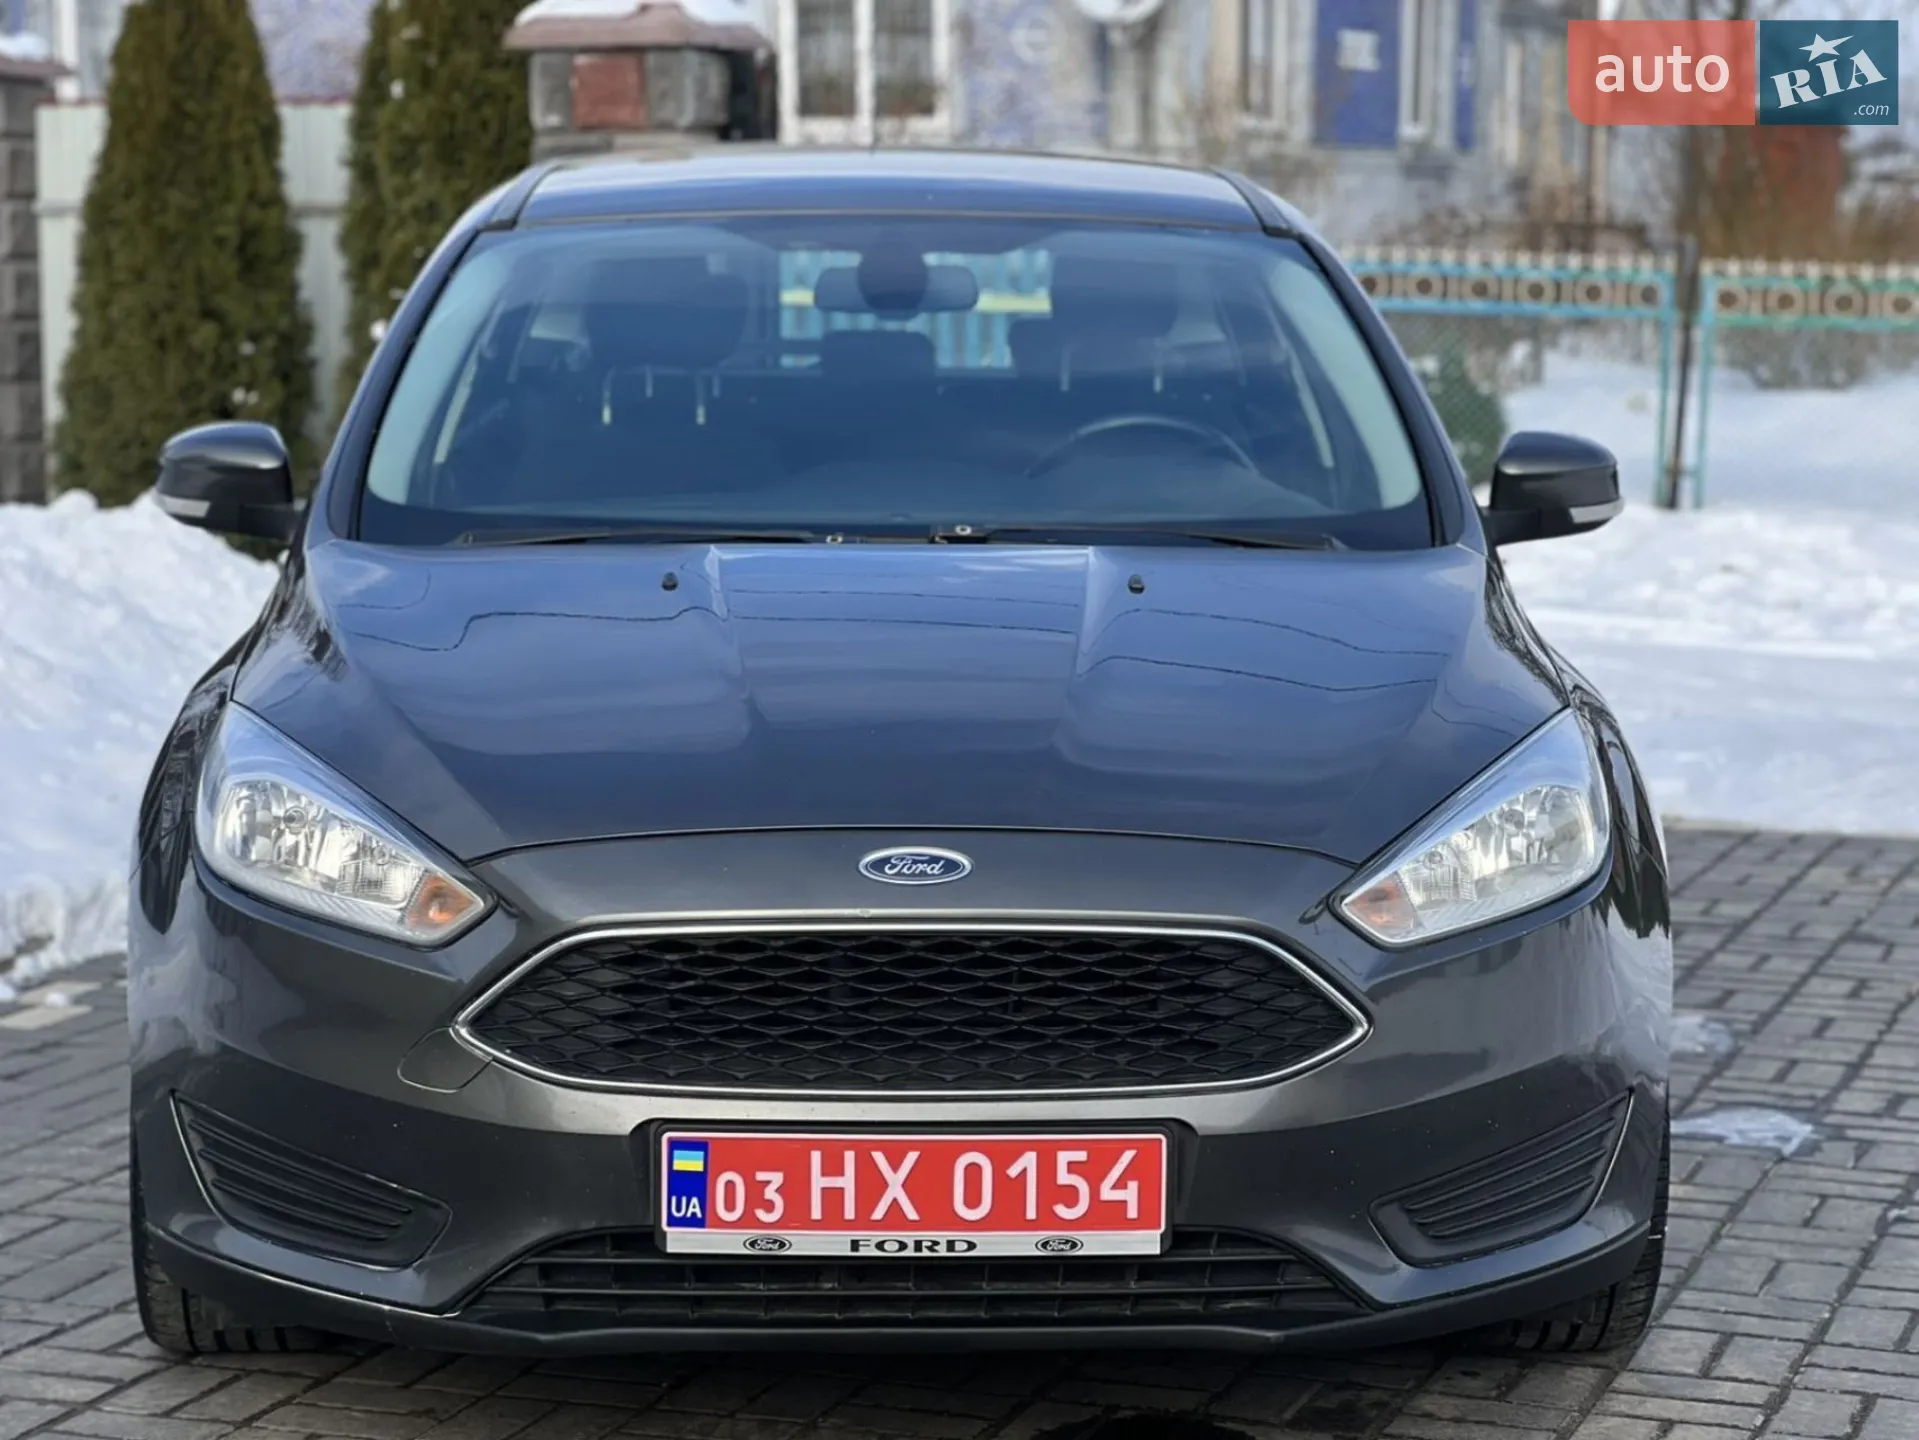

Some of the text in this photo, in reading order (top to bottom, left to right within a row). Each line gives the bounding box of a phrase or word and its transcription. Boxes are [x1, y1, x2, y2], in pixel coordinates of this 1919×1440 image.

[884, 854, 945, 875] Ford
[715, 1149, 1139, 1223] 03 HX 0154
[671, 1195, 703, 1218] UA
[850, 1239, 978, 1253] FORD
